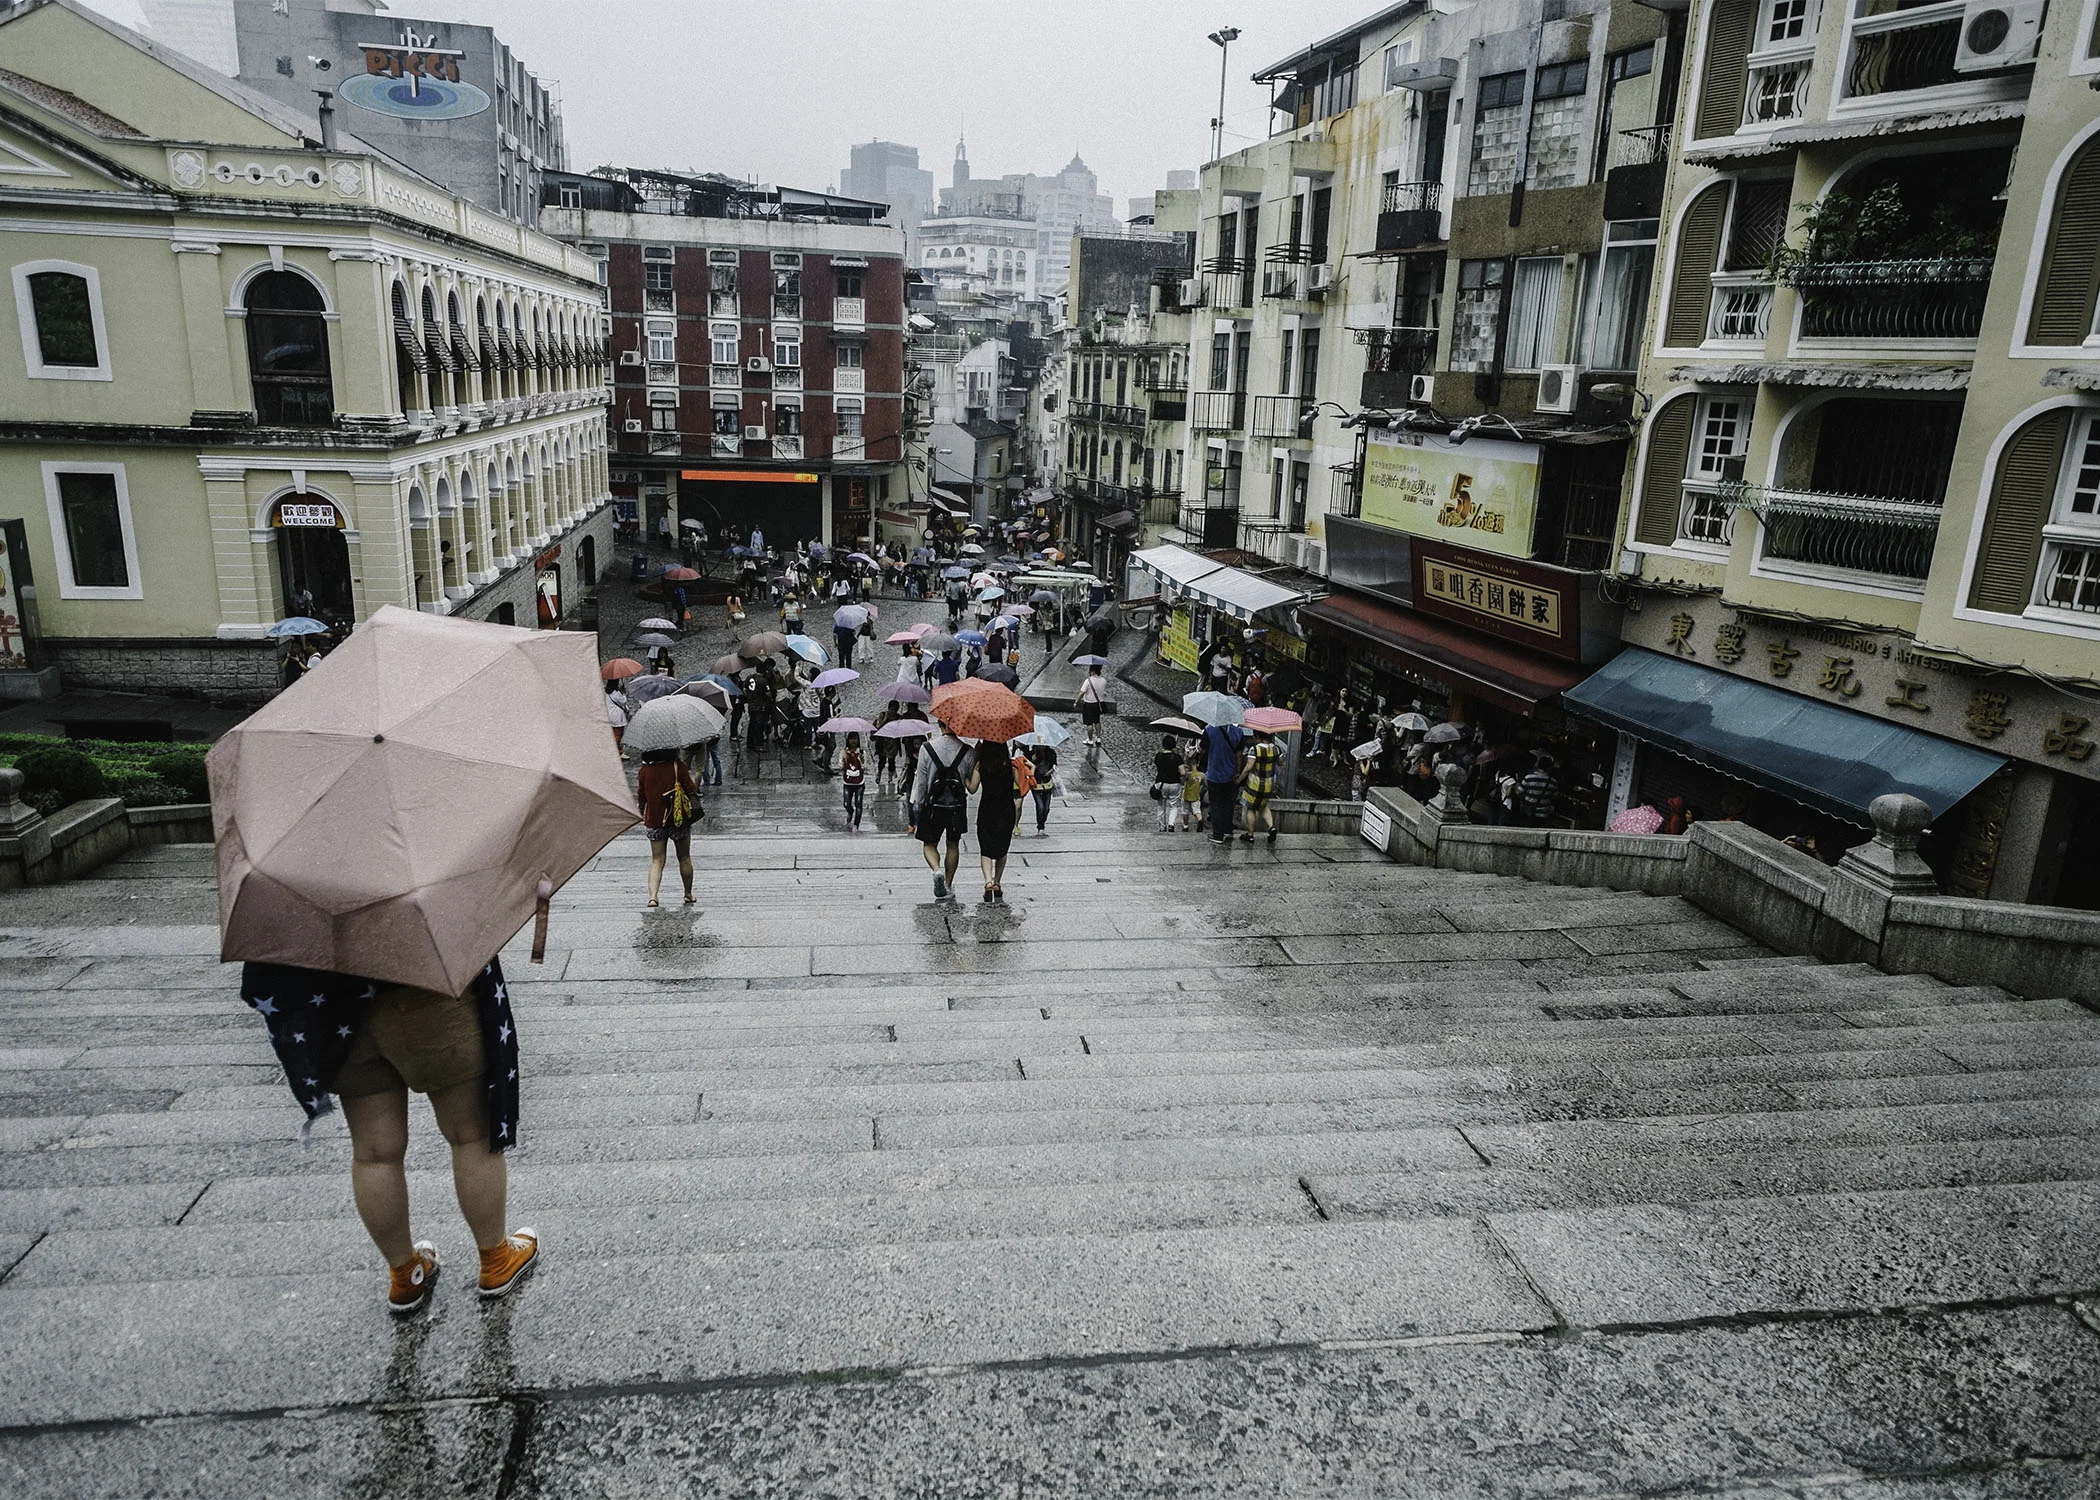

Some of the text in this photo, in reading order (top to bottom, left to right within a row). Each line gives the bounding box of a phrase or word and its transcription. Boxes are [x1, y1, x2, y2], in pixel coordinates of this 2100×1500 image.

[1449, 573, 1550, 624] 咀香園餅家
[748, 678, 756, 691] 3
